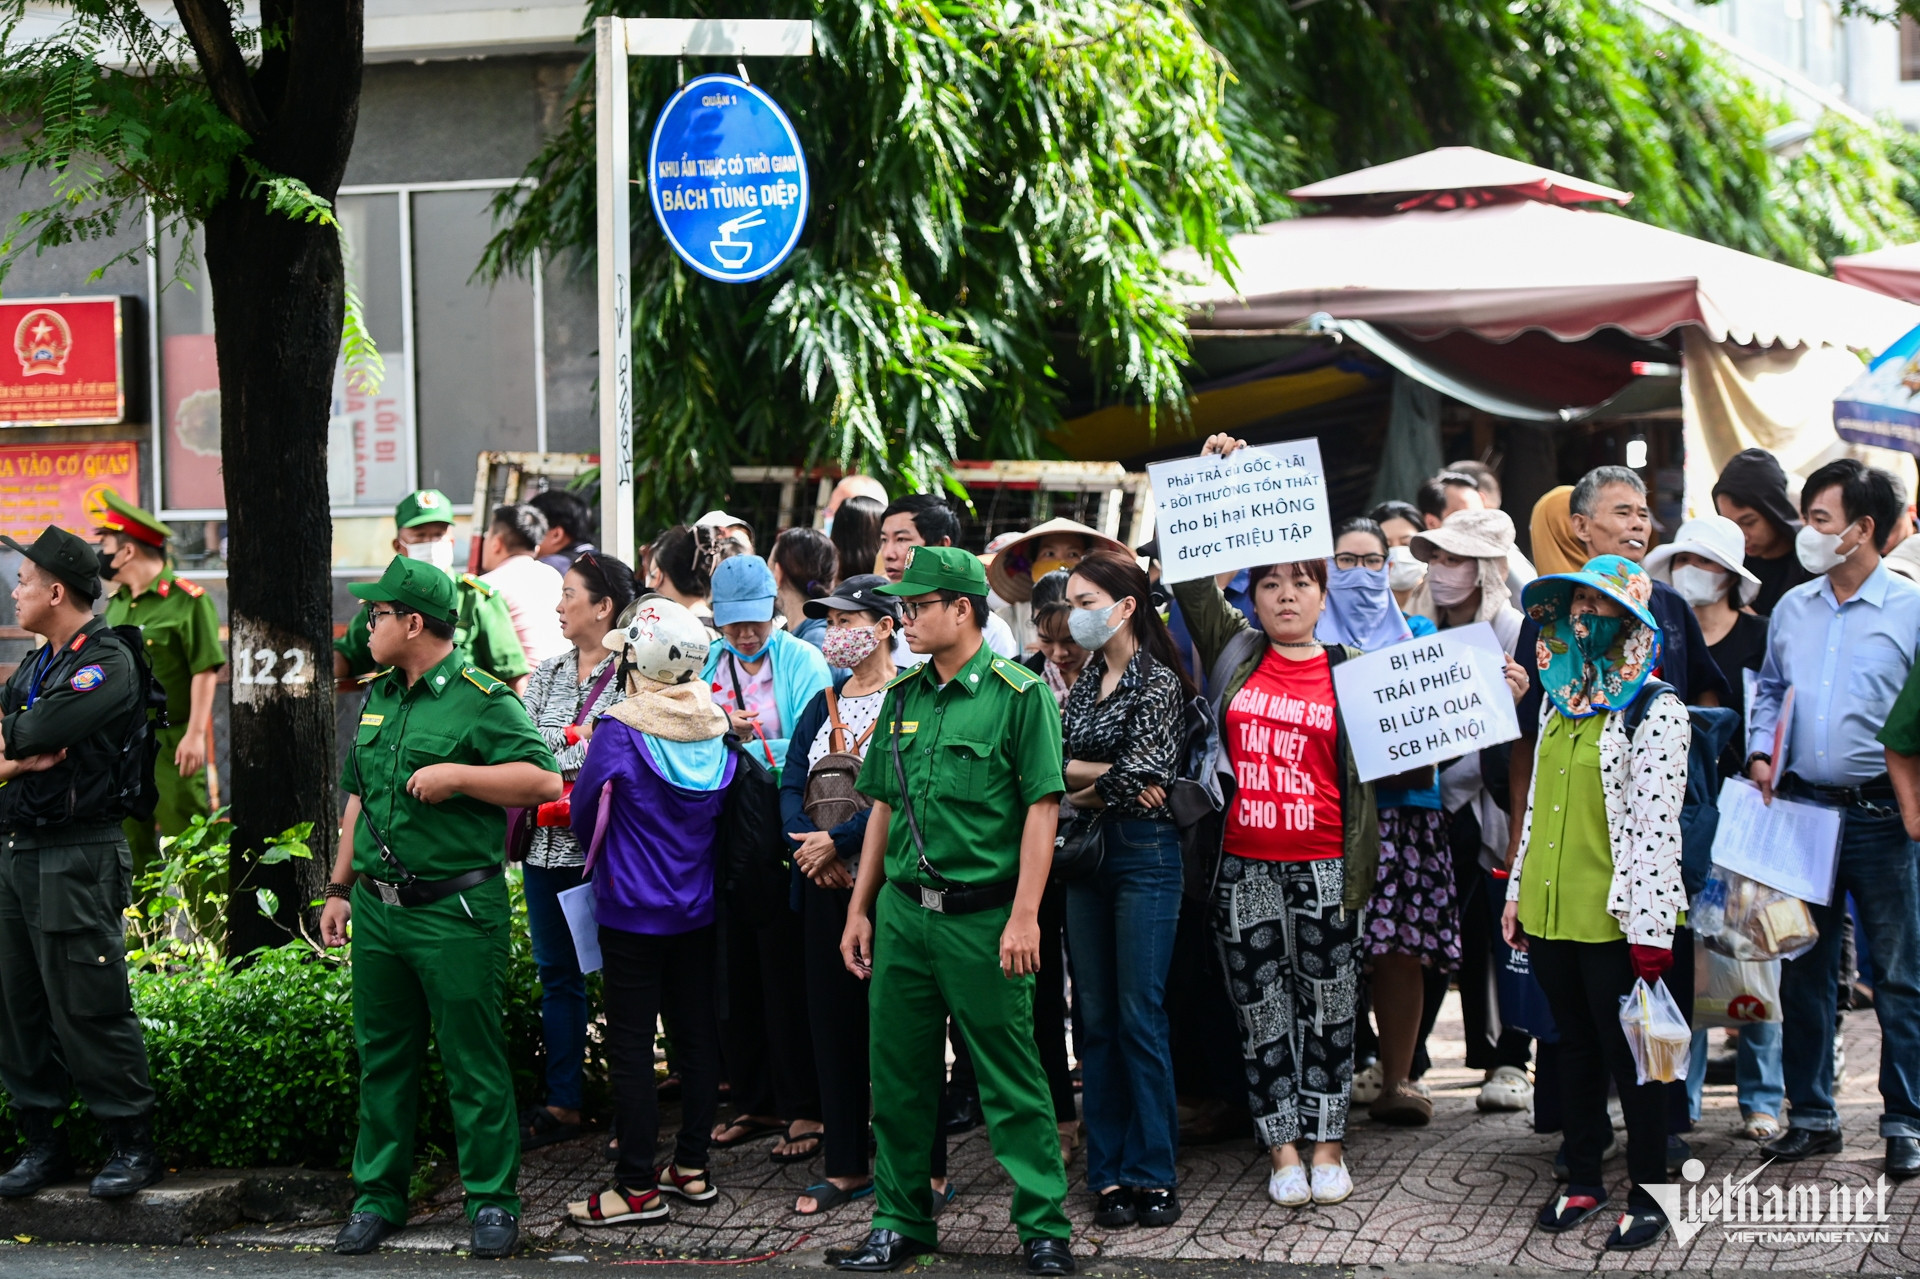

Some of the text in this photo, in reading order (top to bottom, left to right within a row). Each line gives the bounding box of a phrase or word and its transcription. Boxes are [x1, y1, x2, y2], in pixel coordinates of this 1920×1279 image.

[731, 95, 738, 106] 1
[658, 152, 798, 180] KHU ẨM THỰC CÓ THỜI GIAN
[662, 178, 799, 211] BÁCH TÙNG DIỆP
[1167, 473, 1194, 489] Phải
[1199, 465, 1222, 483] TRẢ
[1243, 457, 1271, 474] GỐC
[1275, 461, 1282, 469] +
[1285, 454, 1305, 469] LÃI
[1160, 501, 1167, 510] +
[1170, 493, 1192, 509] BỒI
[1195, 483, 1251, 504] THƯỜNG
[1285, 472, 1320, 489] THẤT
[1170, 497, 1315, 534] cho bị hại KHÔNG
[1178, 523, 1313, 560] được TRIỆU TẬP
[240, 648, 306, 684] 122
[1390, 643, 1444, 670] BỊ HẠI
[1374, 662, 1472, 704] TRÁI PHIẾU
[1229, 686, 1334, 731] NGÂN HÀNG SCB
[1379, 692, 1482, 734] BỊ LỪA QUA
[1239, 719, 1308, 764] TÂN VIỆT
[1388, 719, 1485, 761] SCB HÀ NỘI
[1238, 754, 1315, 796] TRẢ TIỀN
[1238, 797, 1315, 831] CHO TÔI
